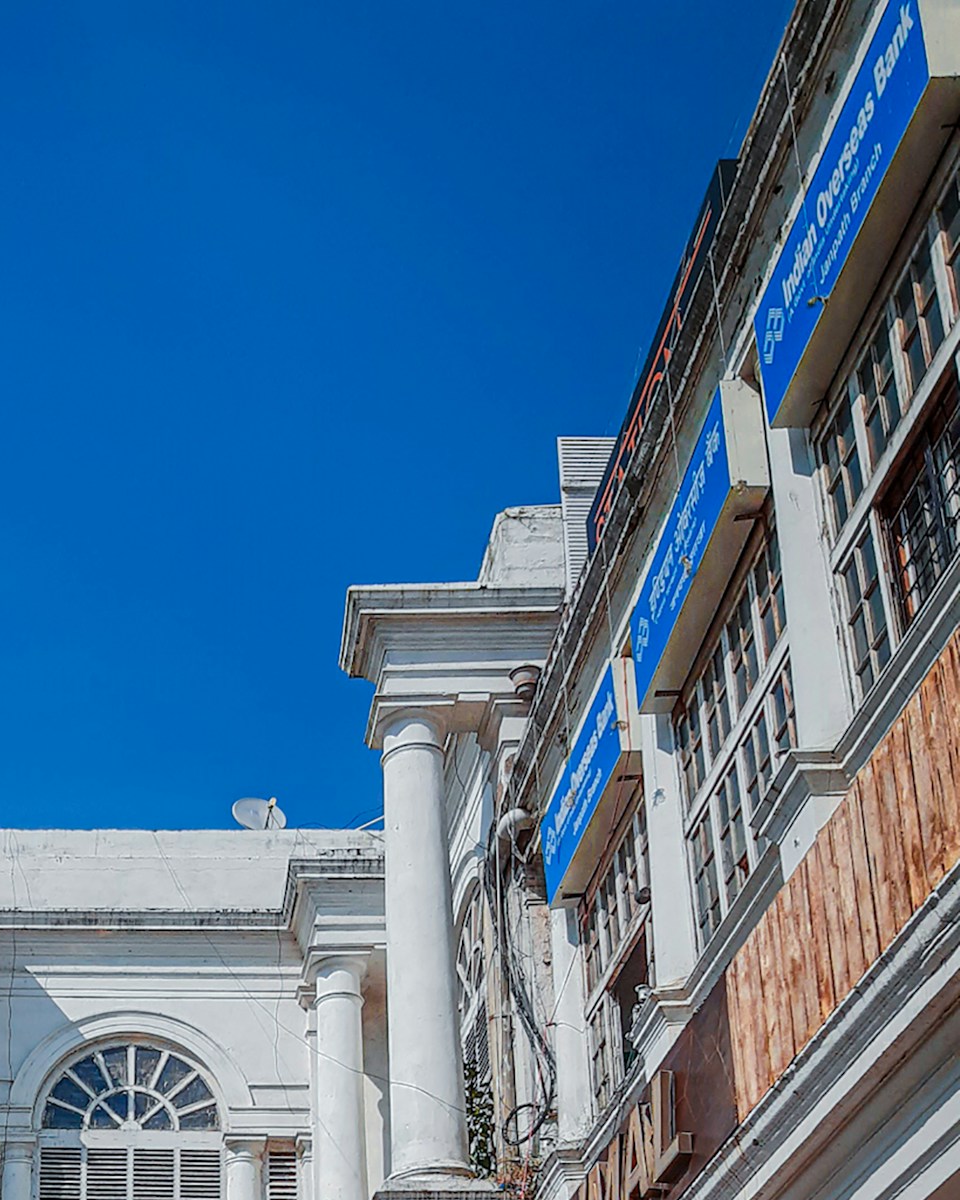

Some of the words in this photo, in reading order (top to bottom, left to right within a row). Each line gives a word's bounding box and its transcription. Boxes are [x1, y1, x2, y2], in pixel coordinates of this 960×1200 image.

[782, 223, 817, 308] Indian
[816, 91, 875, 228] Overseas
[873, 2, 914, 100] Bank
[820, 213, 851, 284] Janpath
[850, 143, 882, 214] Branch
